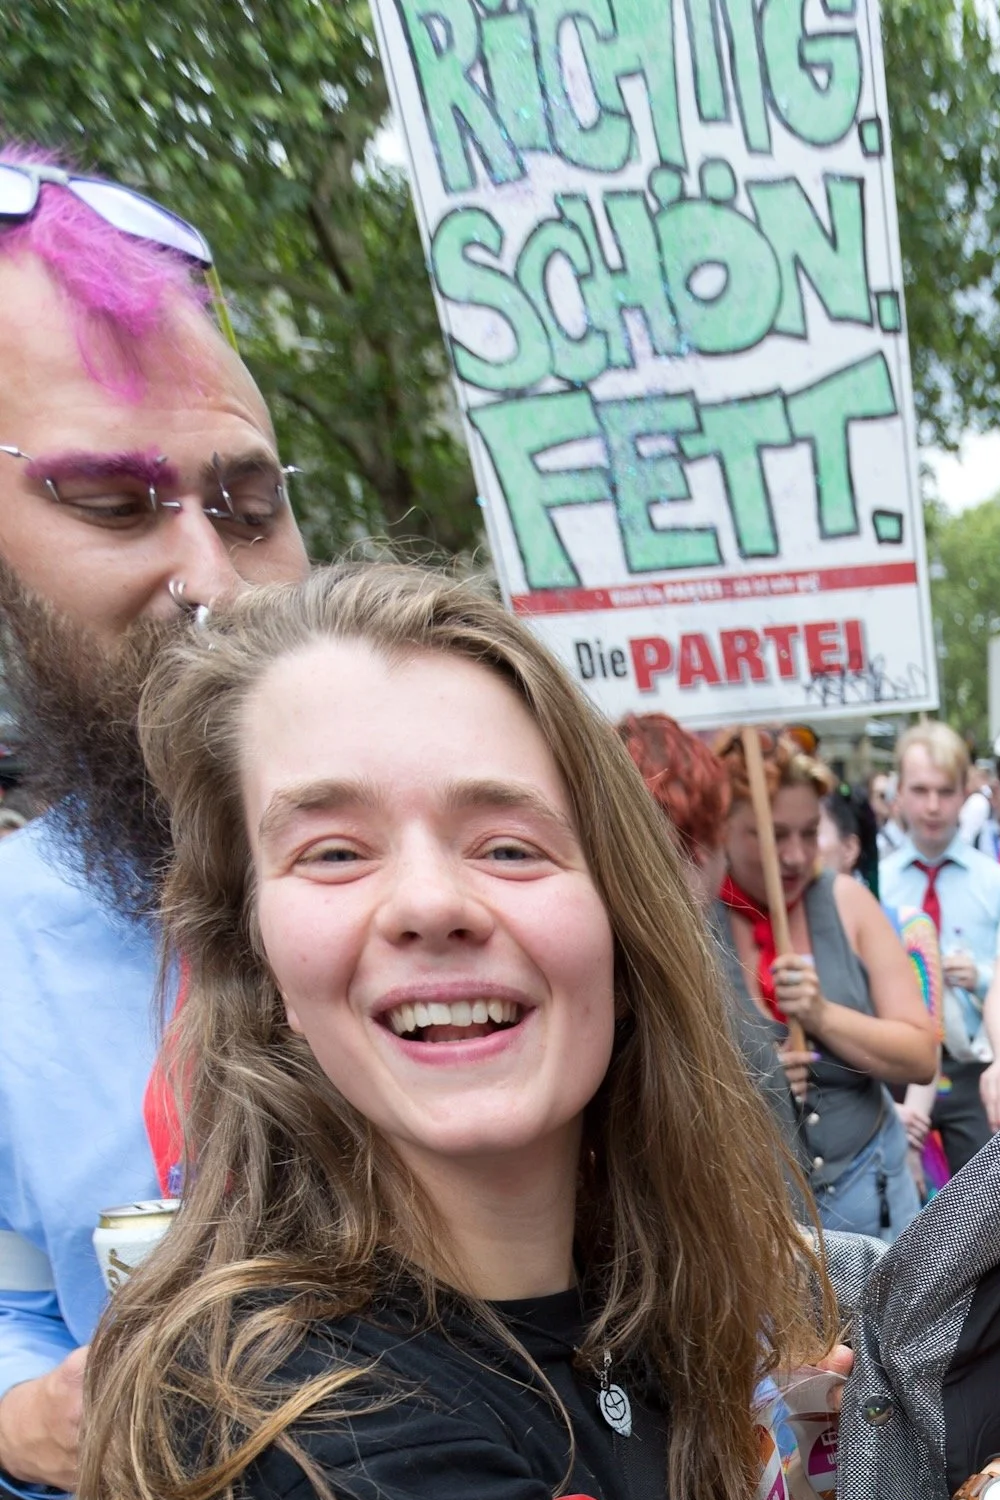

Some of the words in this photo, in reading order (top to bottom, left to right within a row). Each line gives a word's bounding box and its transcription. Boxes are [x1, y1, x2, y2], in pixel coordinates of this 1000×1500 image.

[430, 158, 901, 392] SCHÖN.
[467, 350, 904, 591] FETT.
[628, 619, 865, 693] PARTEI
